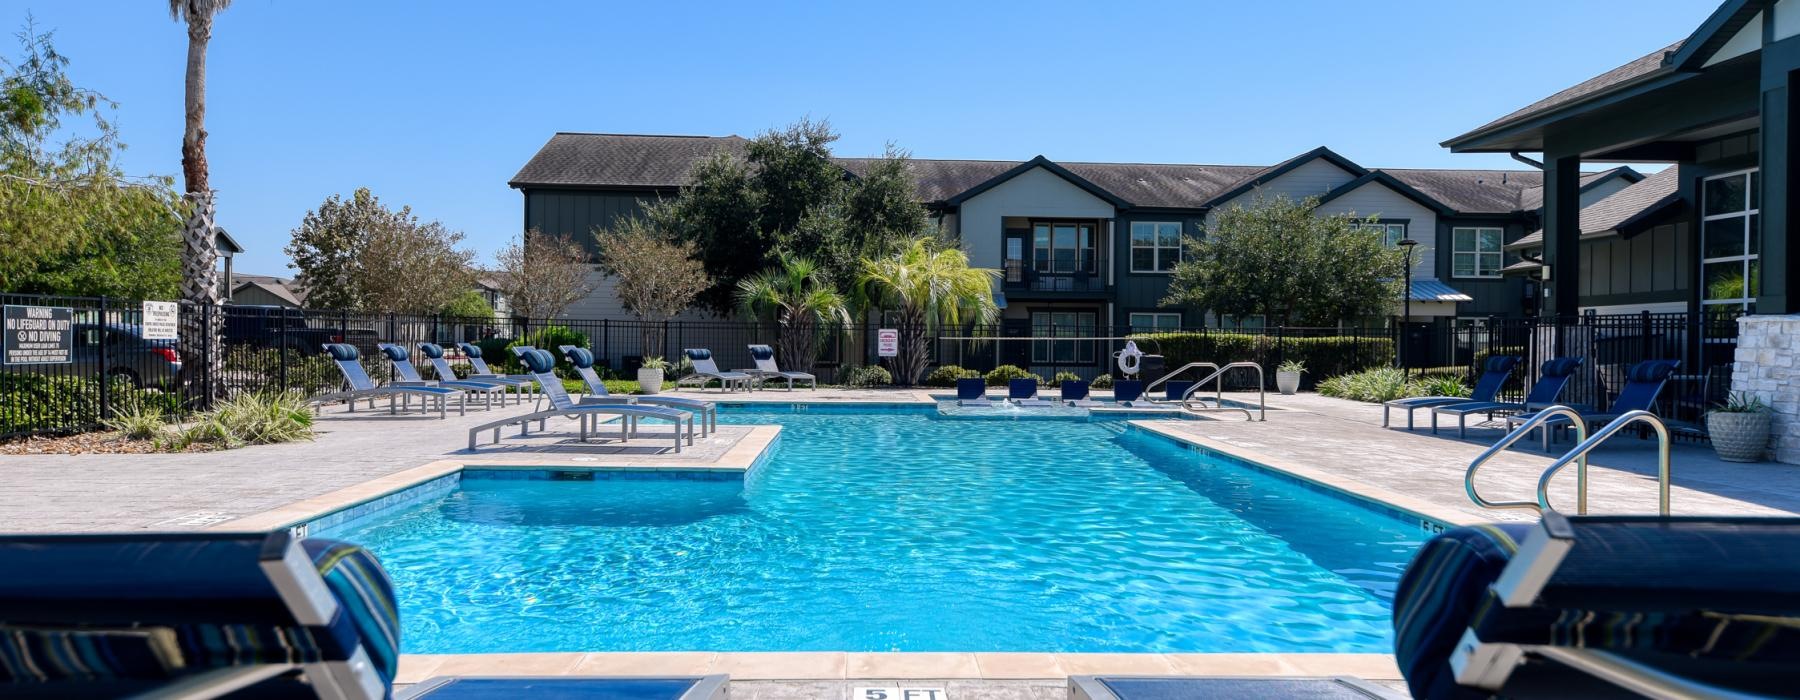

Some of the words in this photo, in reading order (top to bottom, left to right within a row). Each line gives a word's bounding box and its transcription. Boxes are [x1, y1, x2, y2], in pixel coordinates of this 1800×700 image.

[27, 308, 52, 318] WARNING
[7, 319, 15, 329] NO
[17, 319, 47, 330] LIFEGUARD
[48, 320, 55, 330] ON
[57, 320, 70, 330] DUTY
[29, 331, 38, 341] NO
[40, 331, 61, 341] DIVING
[866, 689, 888, 700] 5
[904, 689, 941, 700] FT
